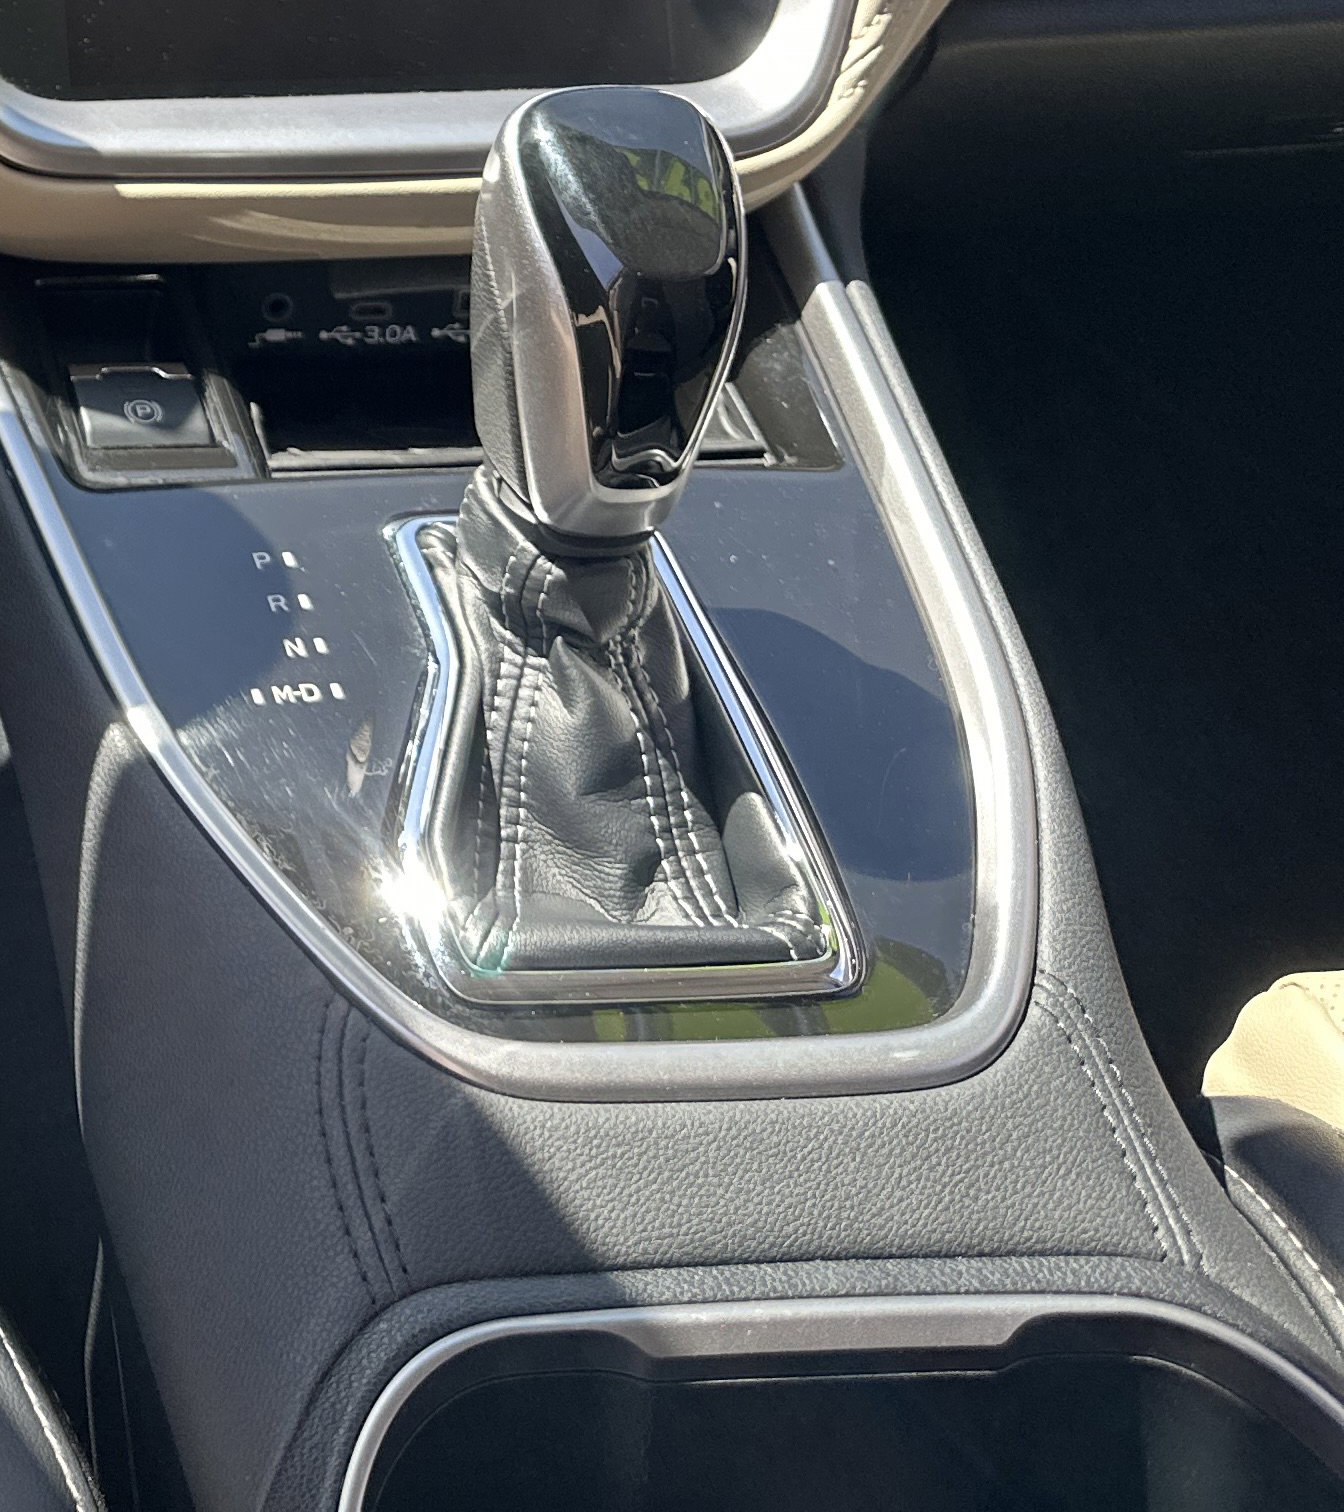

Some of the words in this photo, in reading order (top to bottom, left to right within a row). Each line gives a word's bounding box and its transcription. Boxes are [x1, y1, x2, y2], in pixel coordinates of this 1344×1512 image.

[363, 324, 417, 344] 3.0A
[252, 551, 272, 570] P
[267, 593, 290, 612] R
[282, 637, 309, 658] N
